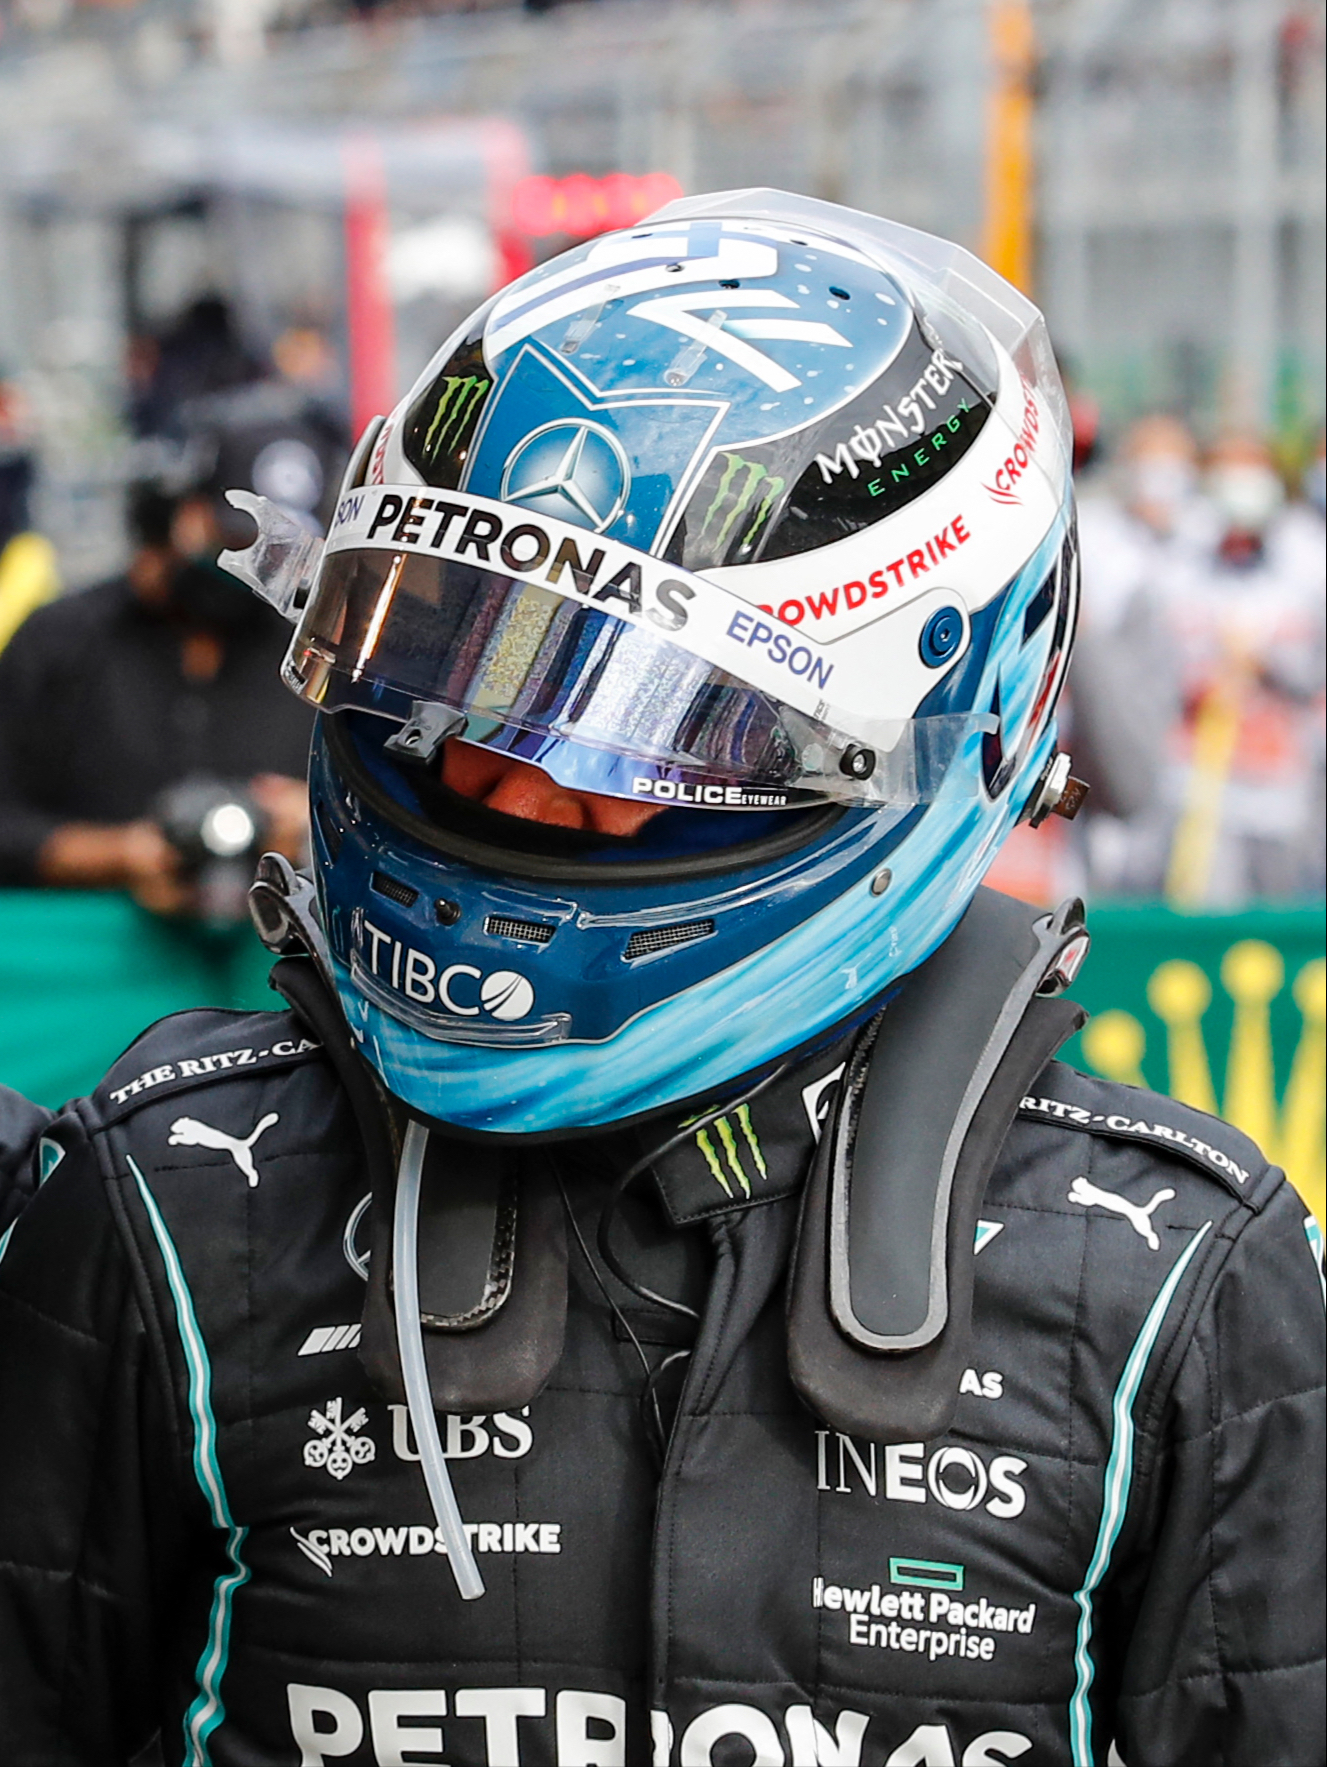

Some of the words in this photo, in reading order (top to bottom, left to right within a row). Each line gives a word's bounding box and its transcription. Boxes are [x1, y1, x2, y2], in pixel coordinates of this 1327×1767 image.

[814, 347, 964, 485] MONSTER
[867, 397, 971, 498] ENERGY
[366, 494, 697, 633] PETRONAS
[725, 609, 834, 691] EPSON
[632, 776, 742, 805] POLICE
[741, 794, 788, 806] EYEWEAR
[109, 1064, 177, 1105] THE
[1018, 1096, 1251, 1185] RITZ-CARLTON
[387, 1404, 534, 1462] UBS
[814, 1430, 1029, 1519] INEOS
[308, 1522, 562, 1556] CROWDSTRIKE
[812, 1577, 926, 1622] Hewlett
[928, 1592, 1037, 1634] Packard
[848, 1613, 997, 1662] Enterprise
